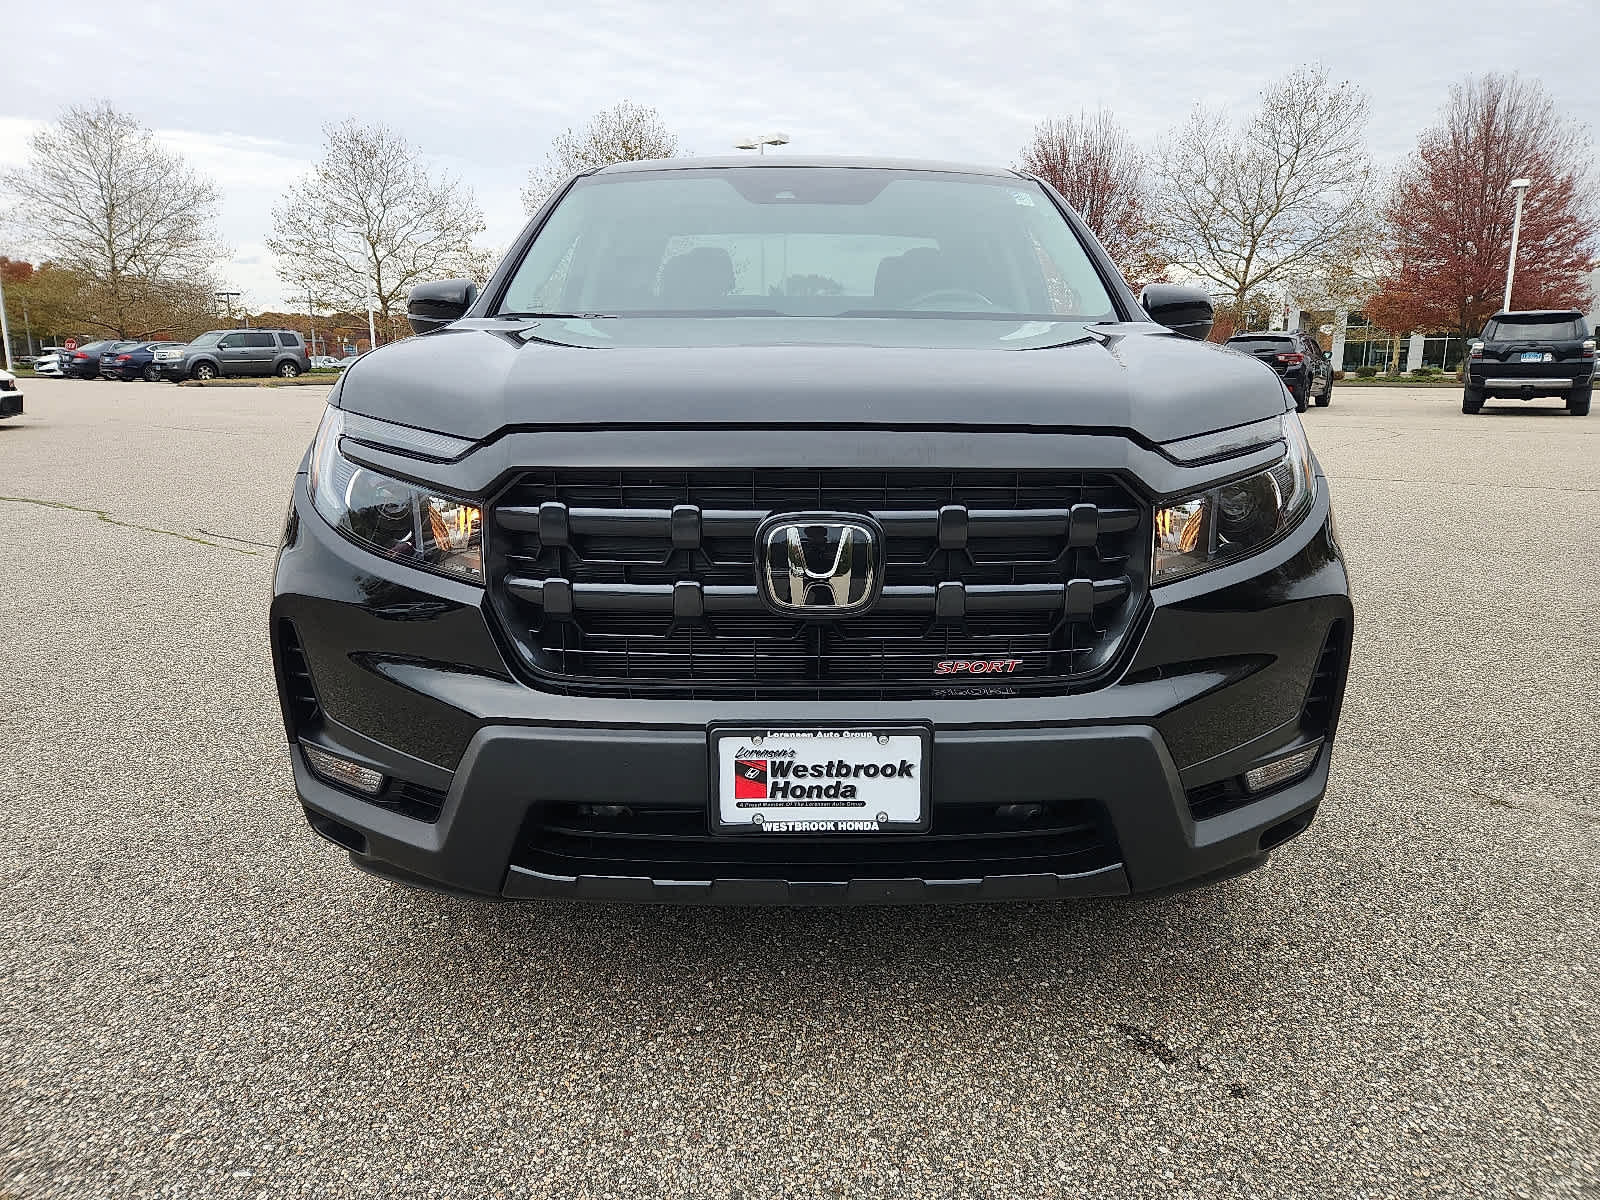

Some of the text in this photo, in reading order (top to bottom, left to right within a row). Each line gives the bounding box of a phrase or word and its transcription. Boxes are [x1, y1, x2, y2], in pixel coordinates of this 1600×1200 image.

[934, 659, 1023, 674] SPORT
[770, 760, 914, 778] Westbrook
[769, 781, 857, 799] Honda
[761, 821, 880, 832] WESTBROOK HONDA
